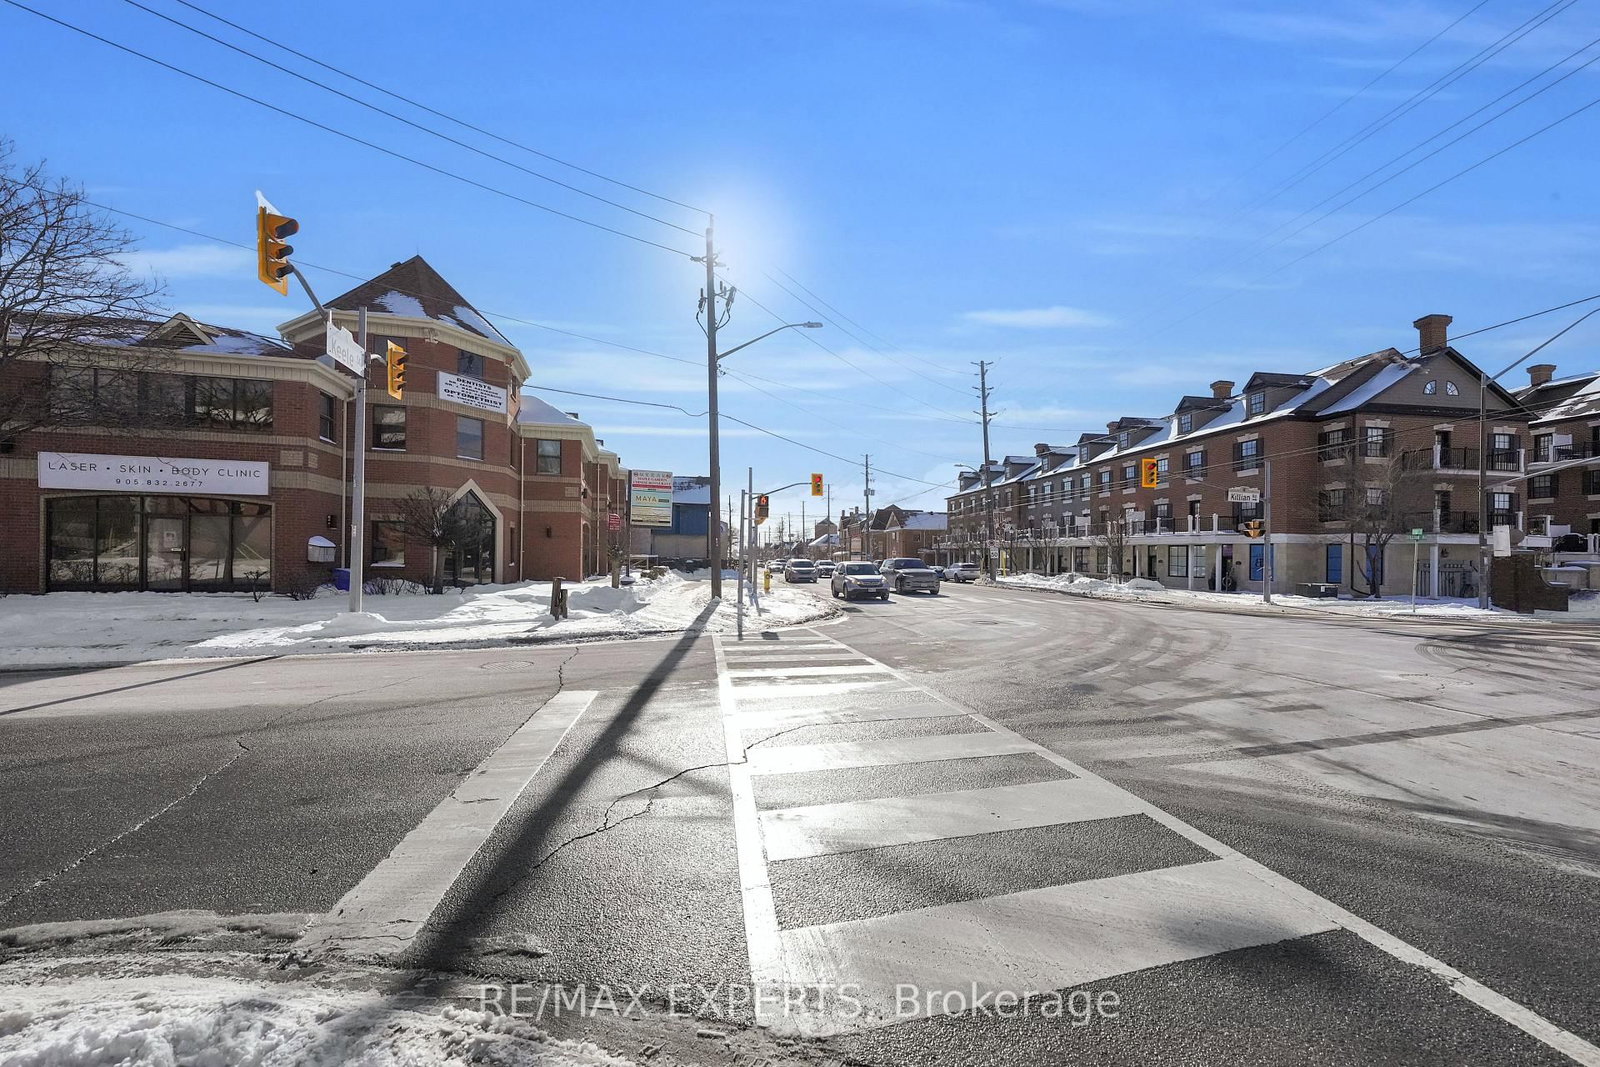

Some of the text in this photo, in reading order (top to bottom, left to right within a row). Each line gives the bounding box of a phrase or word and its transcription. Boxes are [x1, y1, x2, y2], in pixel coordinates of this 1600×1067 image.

[331, 337, 354, 367] Keele
[456, 378, 492, 390] DENTISTS
[444, 388, 502, 406] OPTOMETRIST
[48, 461, 261, 479] LASER SKIN BODY CLINIC
[635, 495, 657, 503] MAYA
[1231, 493, 1250, 501] Killian
